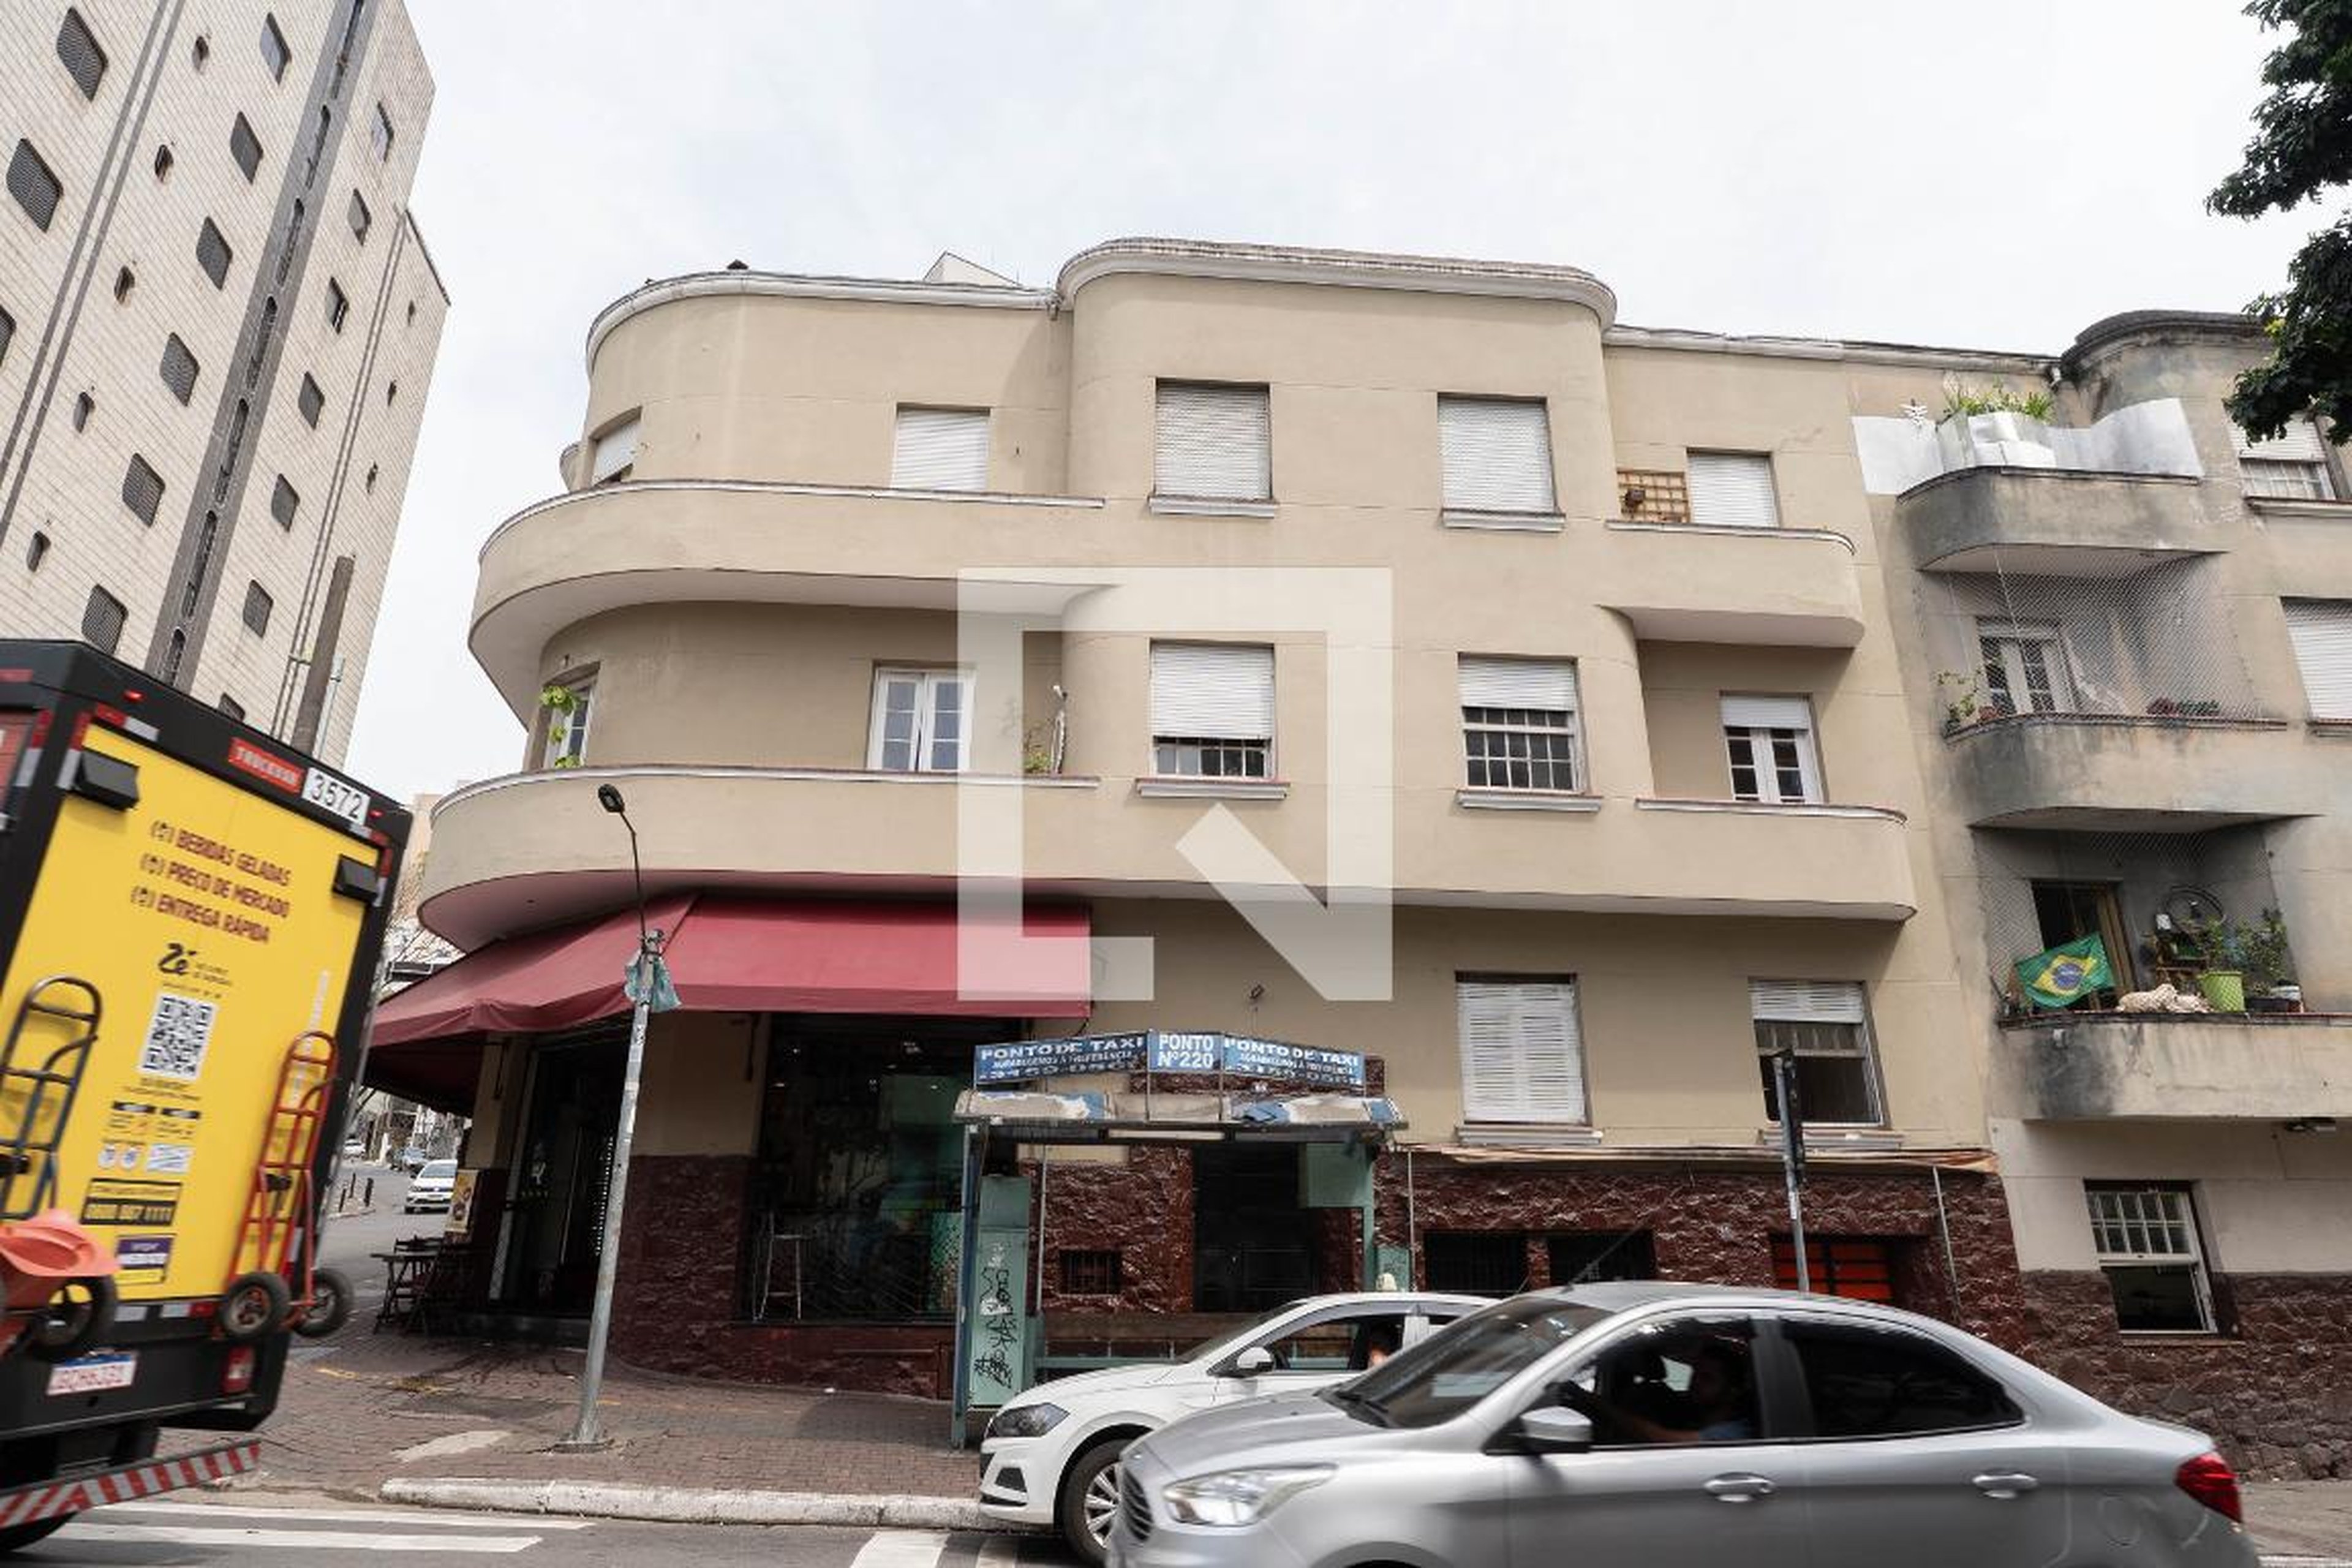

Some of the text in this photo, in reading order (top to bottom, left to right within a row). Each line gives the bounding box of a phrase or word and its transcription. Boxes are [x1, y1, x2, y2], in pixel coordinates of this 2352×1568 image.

[311, 774, 363, 819] 3572
[176, 829, 292, 886] BEBIDAS GELADAS
[157, 893, 220, 927] ENTREGA
[212, 877, 233, 899] DE
[232, 885, 290, 918] MERCADO
[981, 1036, 1144, 1060] PONTO DE TAXI
[1159, 1034, 1214, 1052] PONTO
[1224, 1038, 1359, 1066] PONTO DE TAXI
